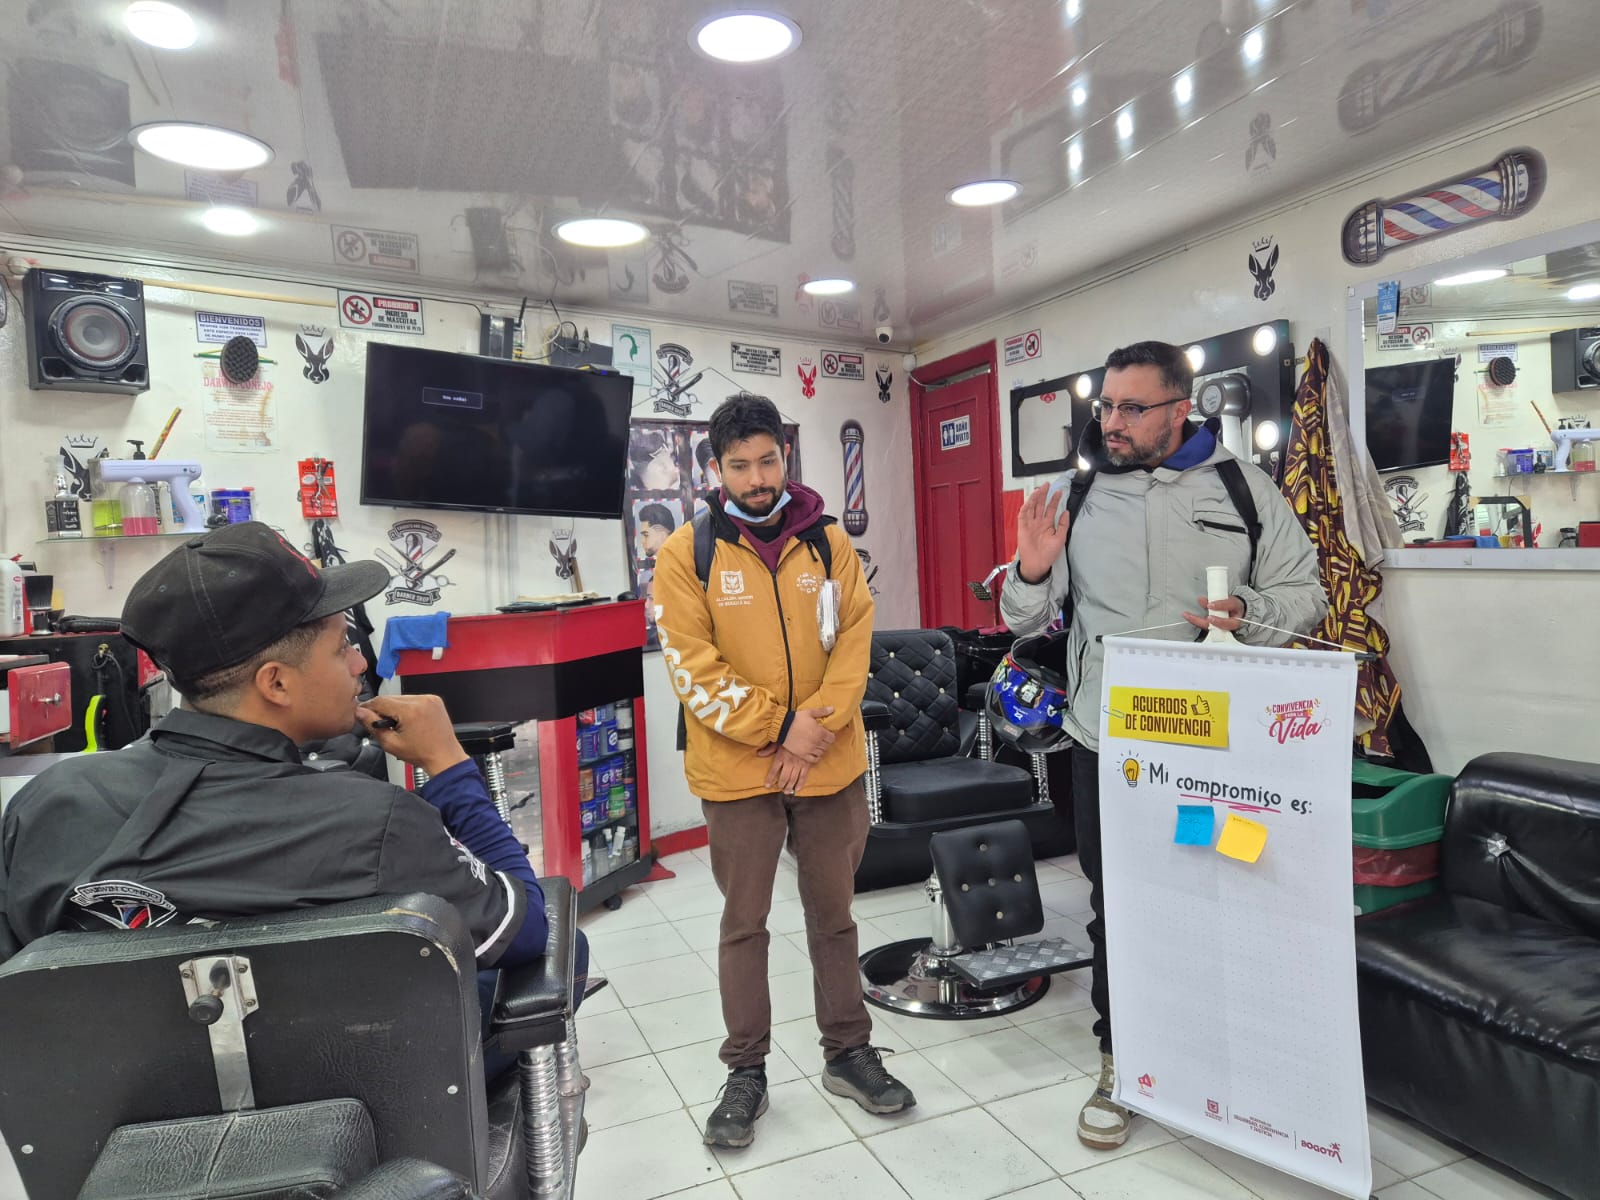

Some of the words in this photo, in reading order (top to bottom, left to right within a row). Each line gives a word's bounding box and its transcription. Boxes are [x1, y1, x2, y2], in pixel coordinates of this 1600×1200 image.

[200, 314, 261, 327] BIENVENIDOS
[385, 310, 408, 318] INGRESO
[387, 316, 417, 325] MASCOTAS
[956, 421, 968, 433] BAÑO
[956, 432, 969, 443] MIXTO
[396, 590, 416, 601] BARBER
[416, 594, 431, 603] SHOP
[1133, 695, 1188, 716] ACUERDOS
[1272, 700, 1314, 714] CONVIVENCIA
[1125, 713, 1137, 730] DE
[1140, 714, 1211, 738] CONVIVENCIA
[1269, 716, 1322, 745] Vida
[1149, 762, 1169, 785] Mi
[1176, 777, 1282, 807] compromiso
[1291, 799, 1313, 815] es:
[83, 884, 119, 895] DARWIN
[120, 885, 160, 900] CONEJO
